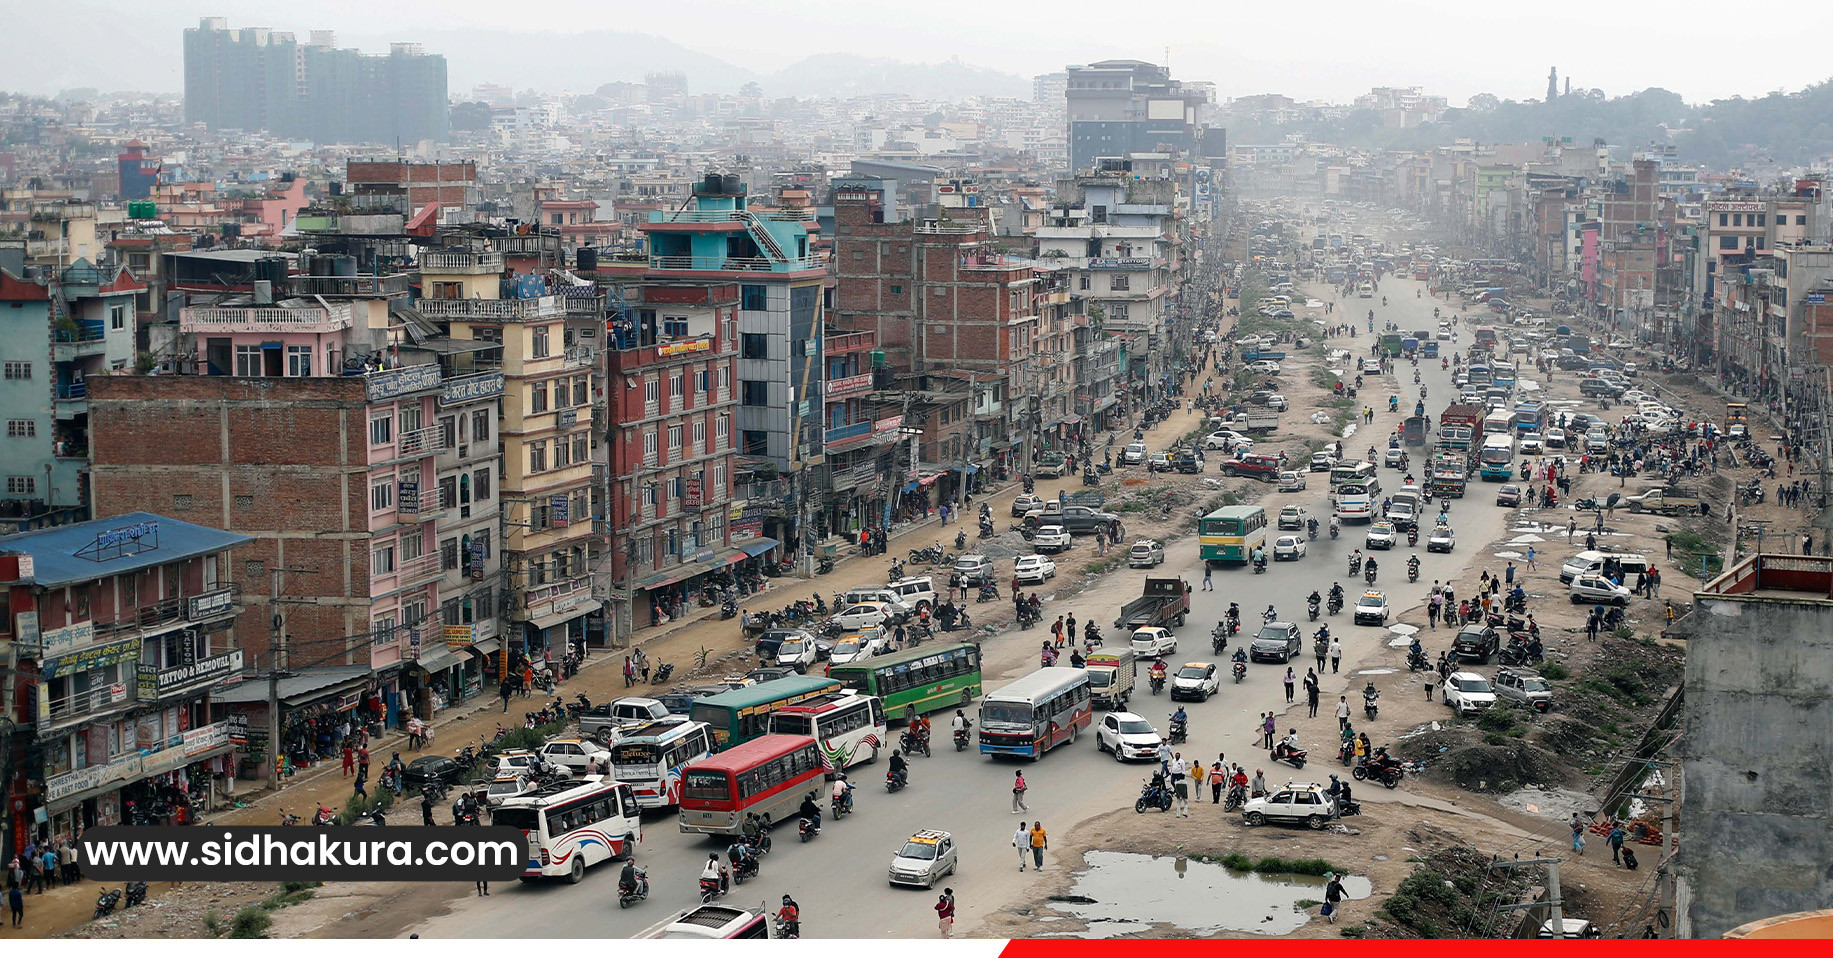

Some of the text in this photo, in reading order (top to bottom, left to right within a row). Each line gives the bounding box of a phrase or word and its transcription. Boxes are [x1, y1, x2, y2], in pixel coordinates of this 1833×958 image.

[398, 373, 420, 385] होटल
[742, 507, 762, 518] TRAVELS
[184, 631, 192, 662] TATTOO
[159, 667, 188, 686] TATTOO
[189, 665, 195, 677] &
[195, 655, 230, 675] REMOVAL
[621, 750, 650, 758] Deluxe
[50, 773, 79, 788] SHRESTHA
[61, 784, 74, 795] FAST
[75, 779, 88, 790] FOOD
